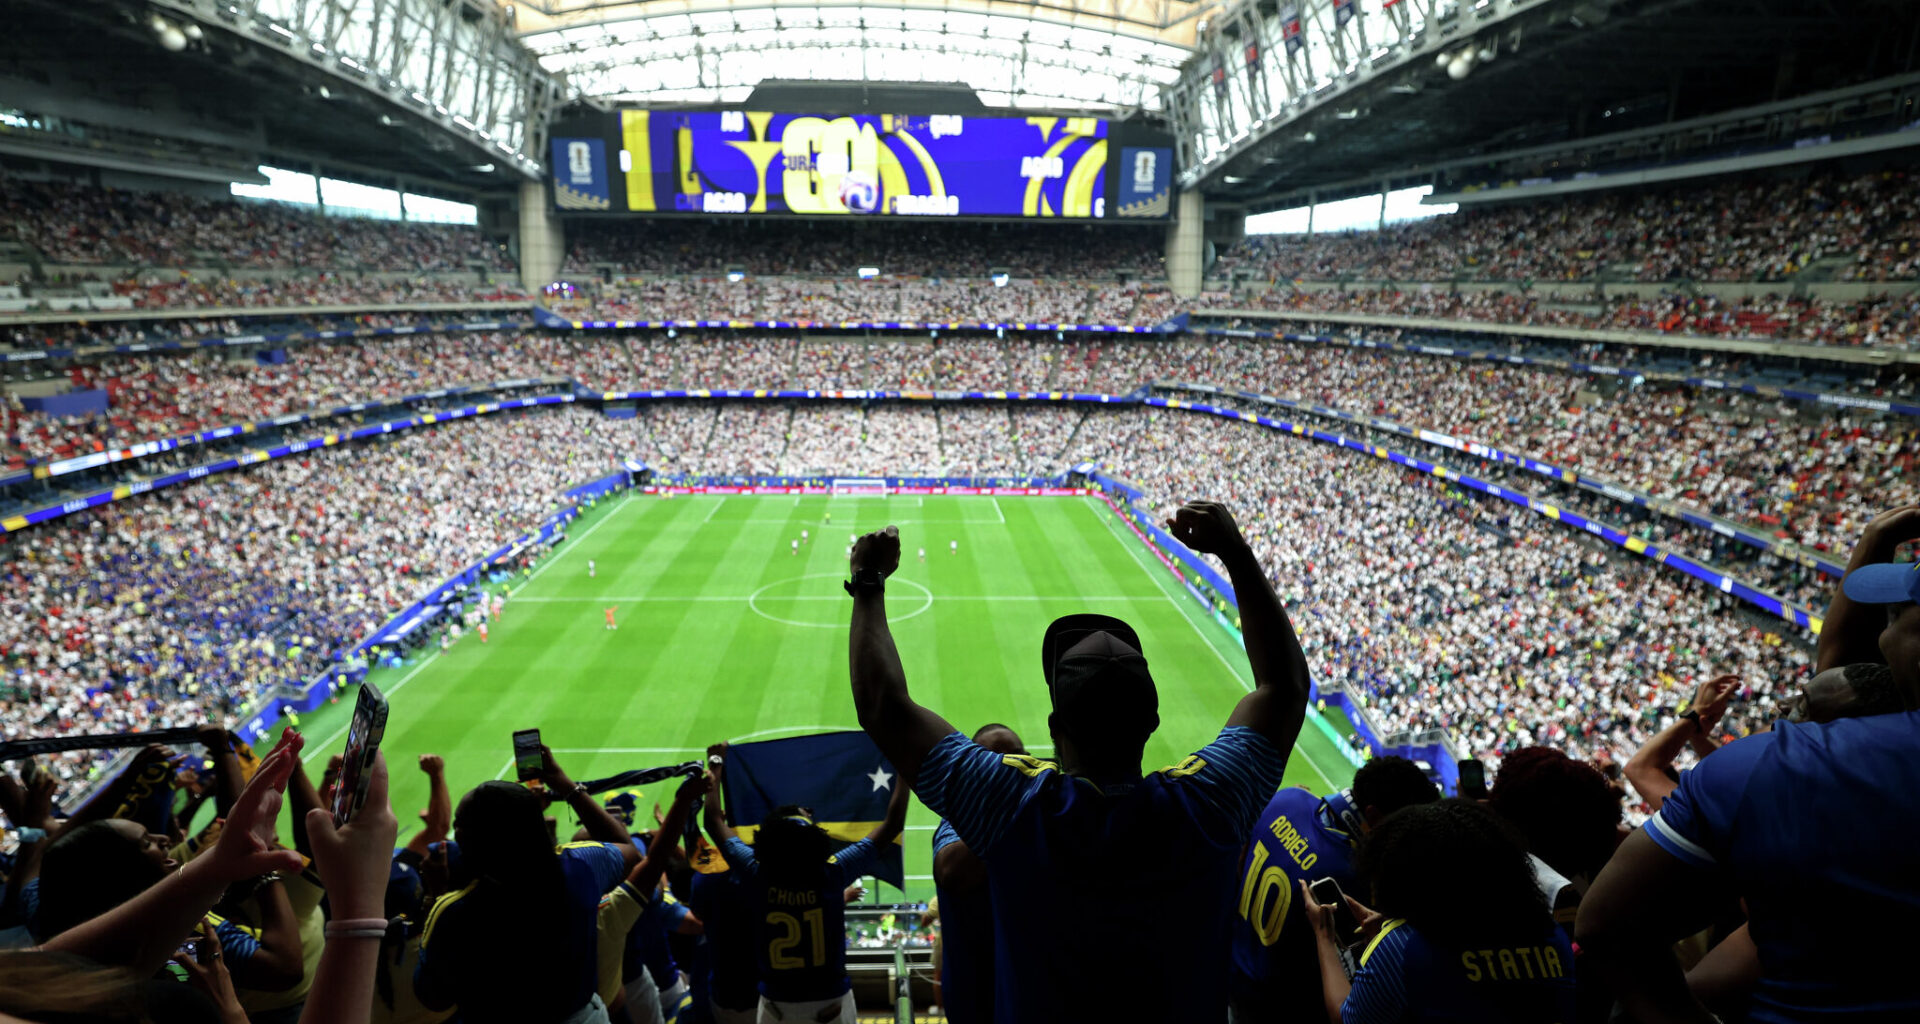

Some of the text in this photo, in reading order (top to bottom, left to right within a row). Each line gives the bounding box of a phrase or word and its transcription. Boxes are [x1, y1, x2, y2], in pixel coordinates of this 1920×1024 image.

[768, 886, 818, 906] CHONG
[1238, 839, 1292, 947] 10
[765, 907, 827, 970] 21
[1461, 946, 1563, 982] STATIA
